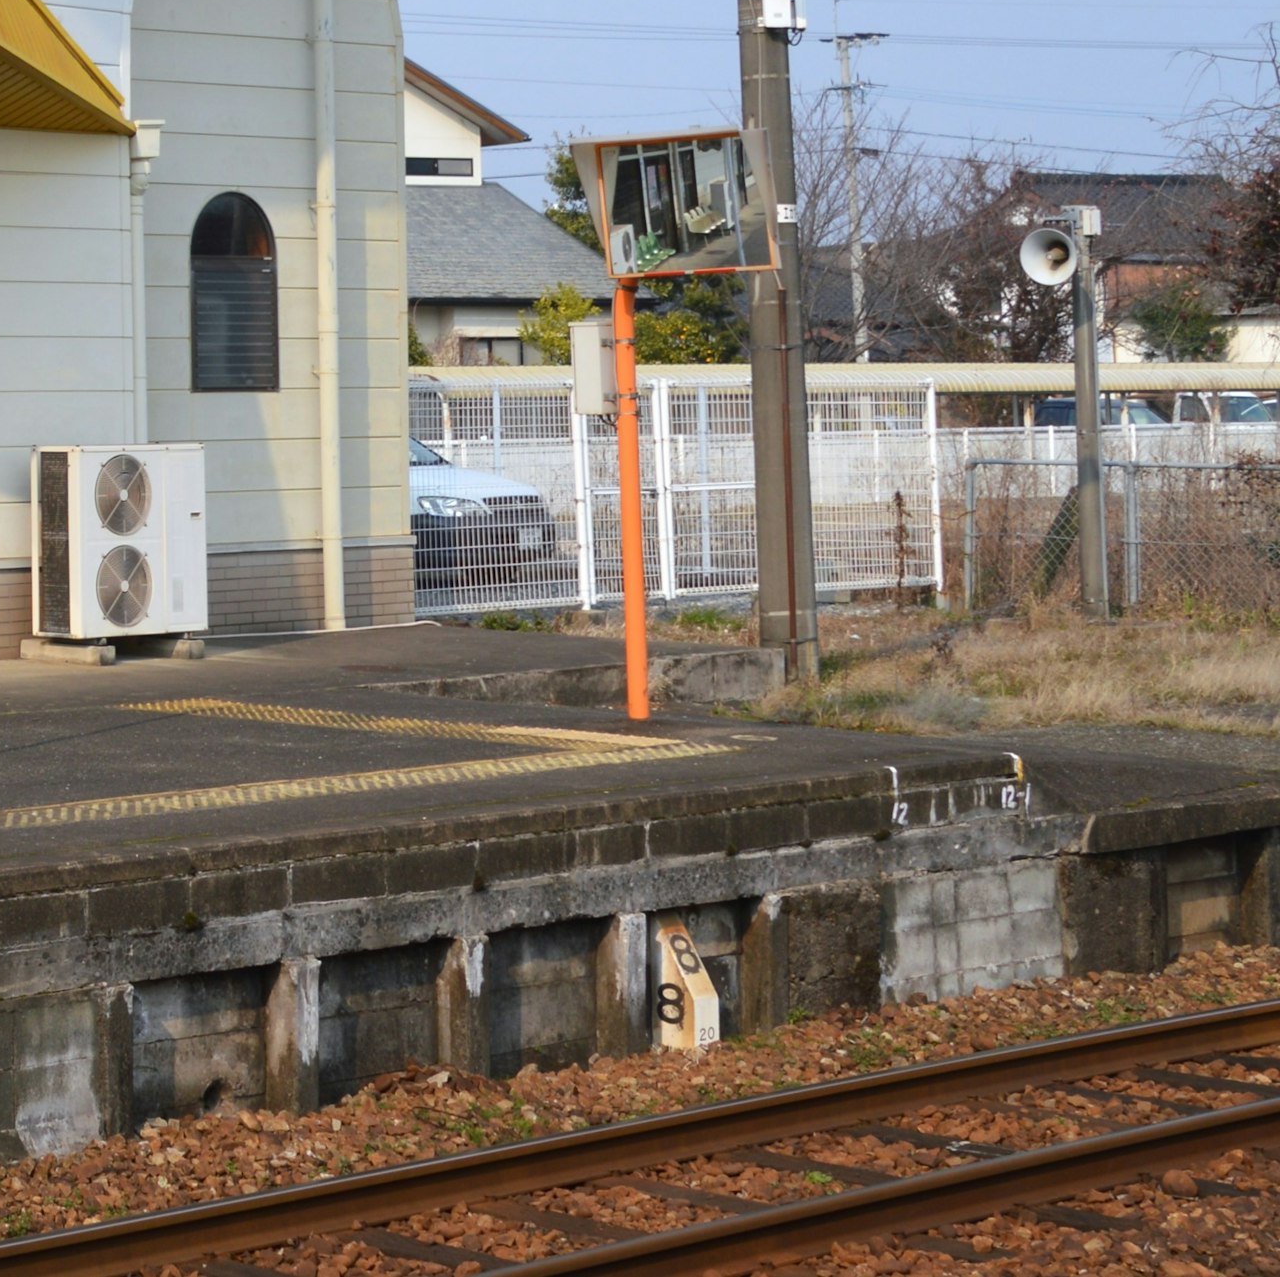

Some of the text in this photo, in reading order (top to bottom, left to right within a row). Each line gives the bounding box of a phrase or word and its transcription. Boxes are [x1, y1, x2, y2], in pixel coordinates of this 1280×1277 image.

[891, 801, 909, 825] 12
[670, 933, 700, 975] 8
[657, 982, 685, 1025] 8
[699, 1026, 716, 1042] 20
